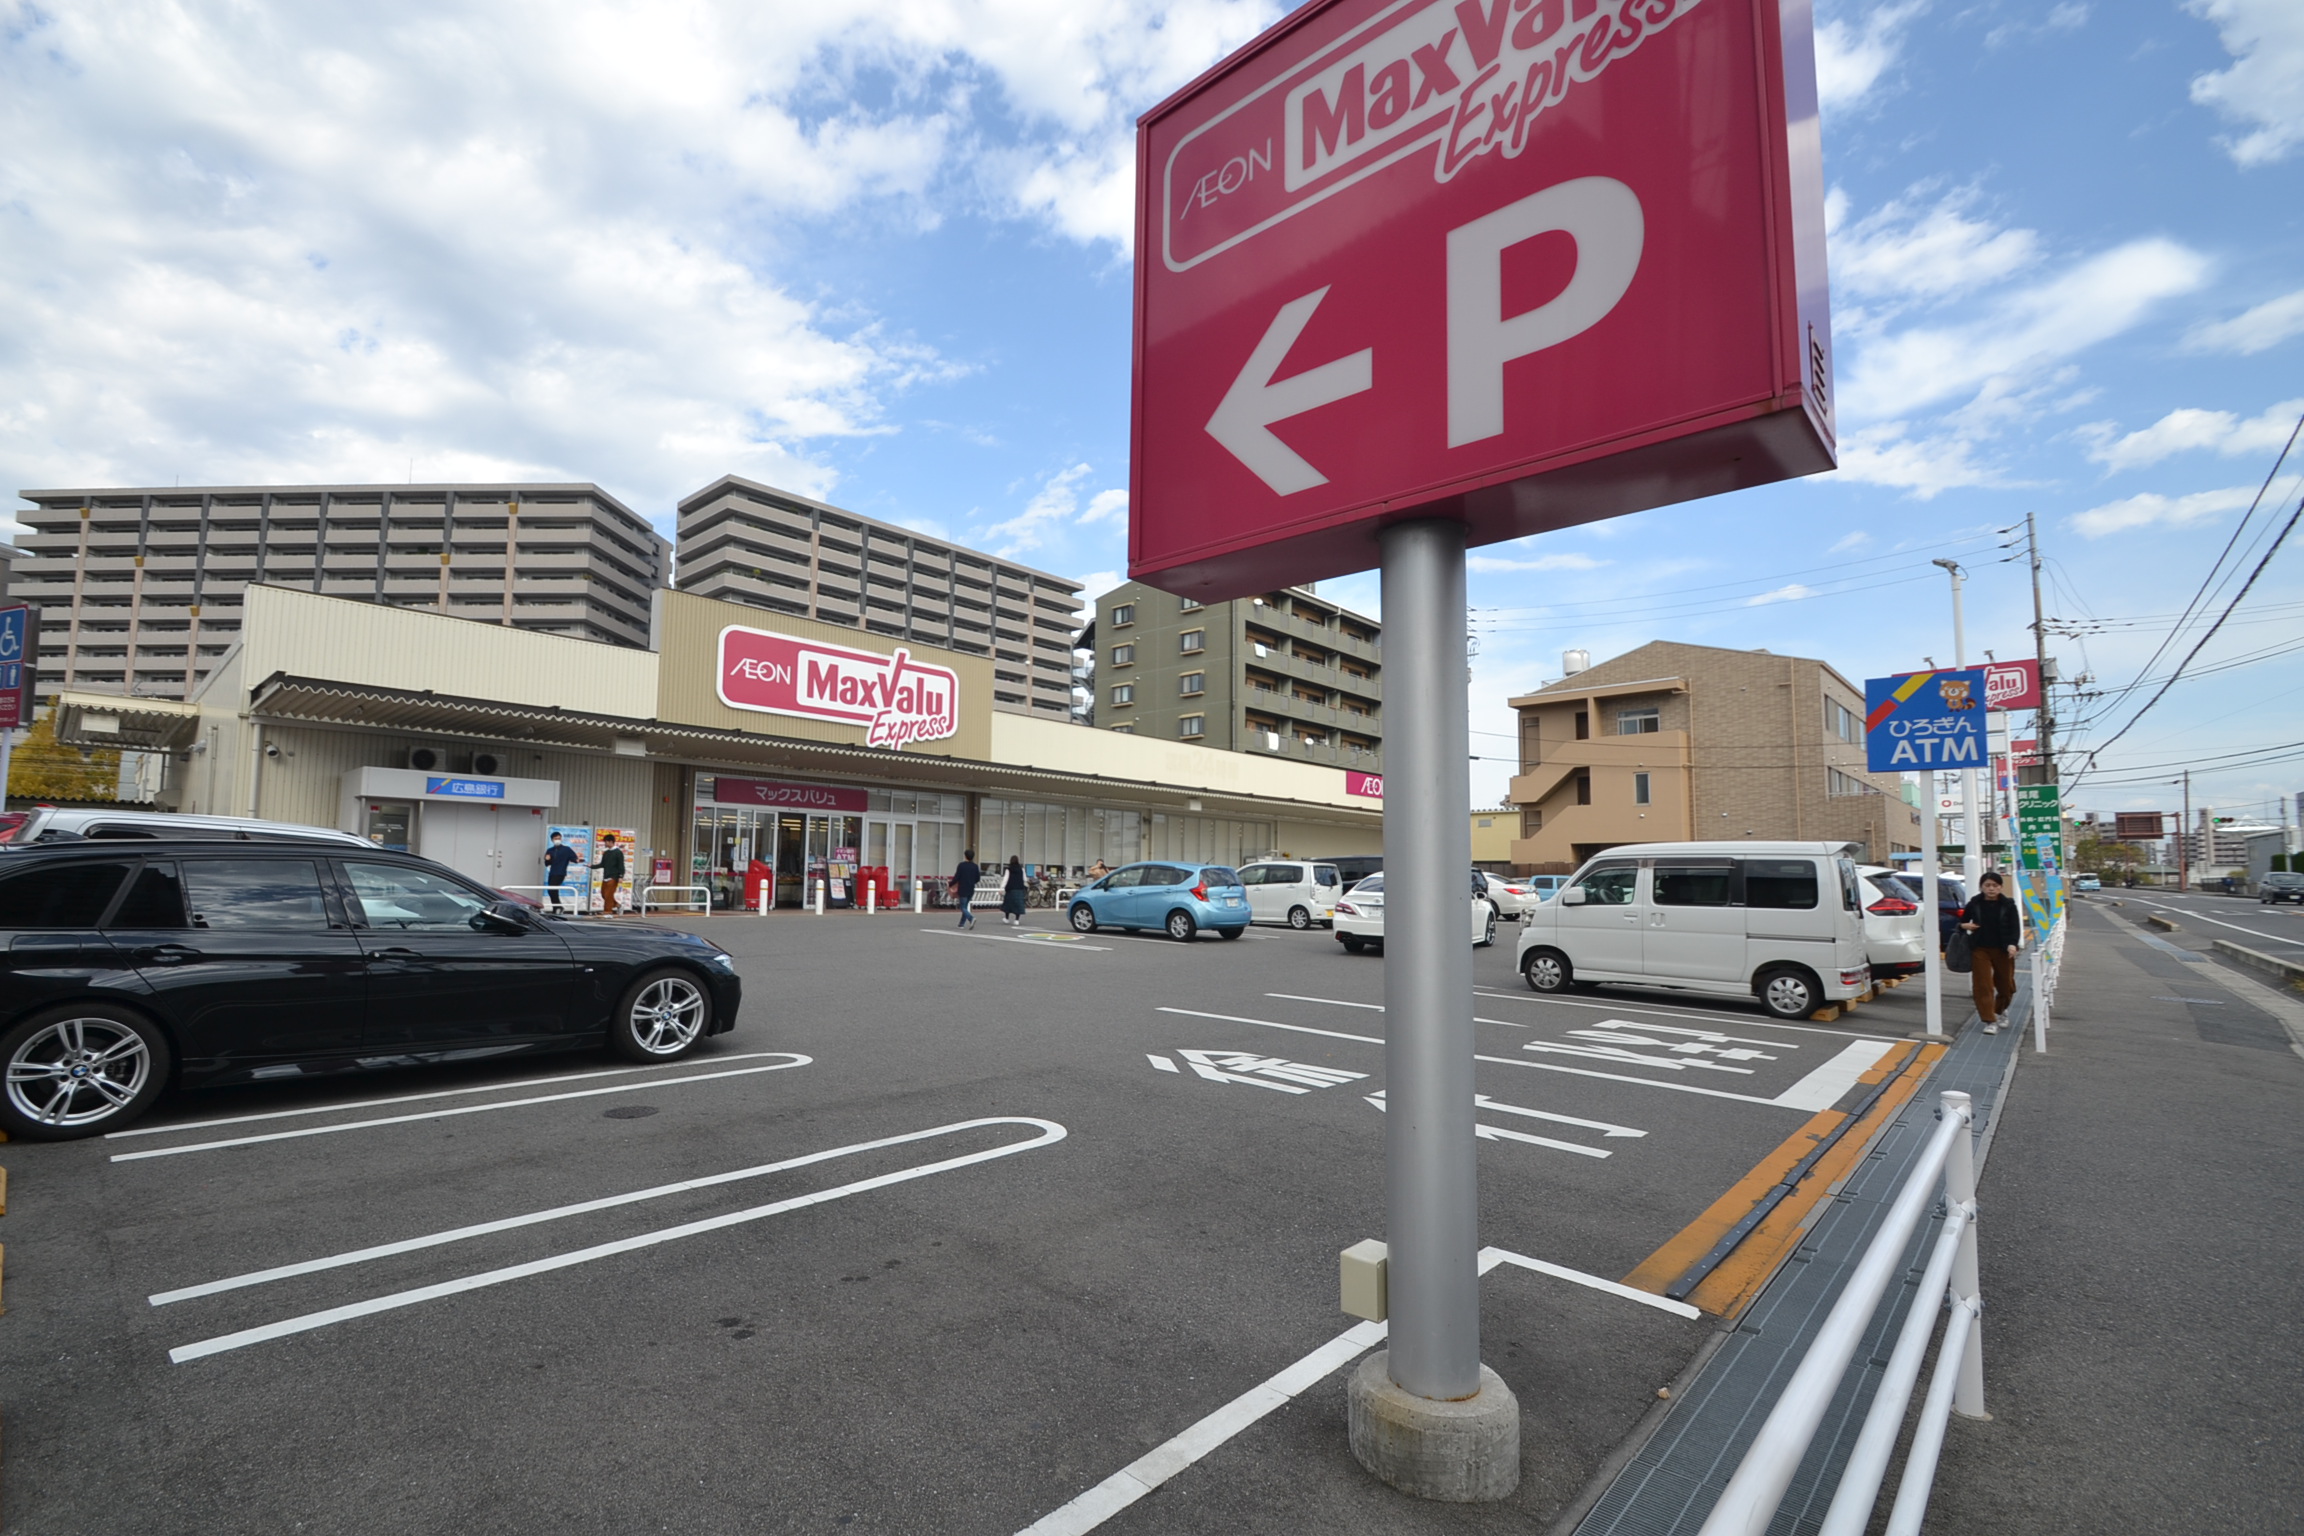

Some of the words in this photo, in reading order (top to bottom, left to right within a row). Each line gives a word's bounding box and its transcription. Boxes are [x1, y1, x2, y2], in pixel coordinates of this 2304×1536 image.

[1302, 0, 1597, 171] MaxVa
[1447, 176, 1644, 449] P
[806, 652, 943, 716] MaxValu
[869, 710, 948, 751] Express
[1889, 716, 1978, 737] ひろぎん
[1890, 736, 1979, 764] ATM
[452, 782, 498, 796] 広島銀行
[755, 786, 836, 805] マックスバリュ
[2019, 799, 2058, 808] クリニック
